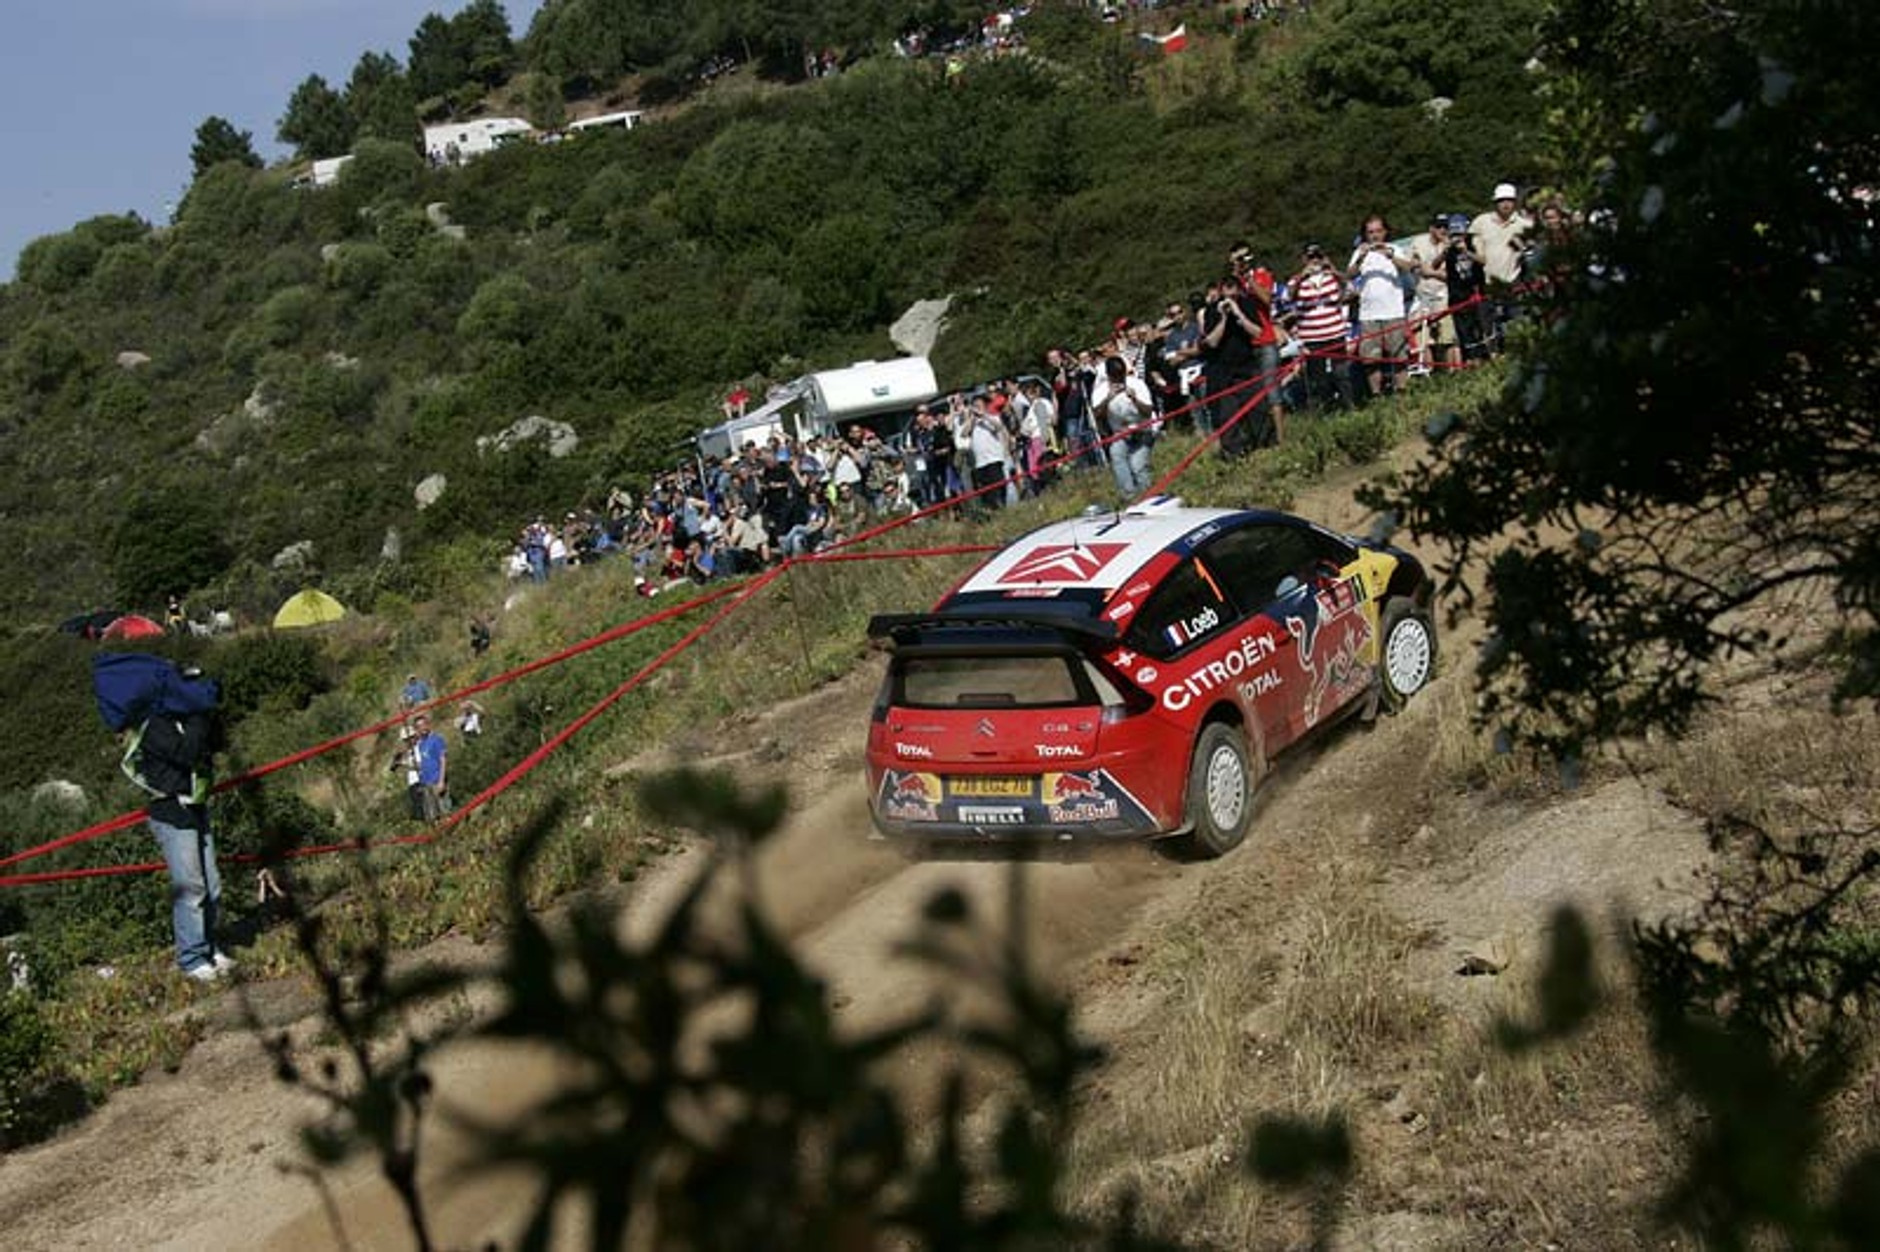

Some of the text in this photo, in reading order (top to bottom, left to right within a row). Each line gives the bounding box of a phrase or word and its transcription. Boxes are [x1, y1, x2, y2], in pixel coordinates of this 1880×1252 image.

[1182, 606, 1219, 639] Loeb
[1163, 632, 1276, 710] CITROËN
[1237, 668, 1282, 701] TOTAL
[895, 742, 933, 757] TOTAL
[1034, 744, 1084, 756] TOTAL
